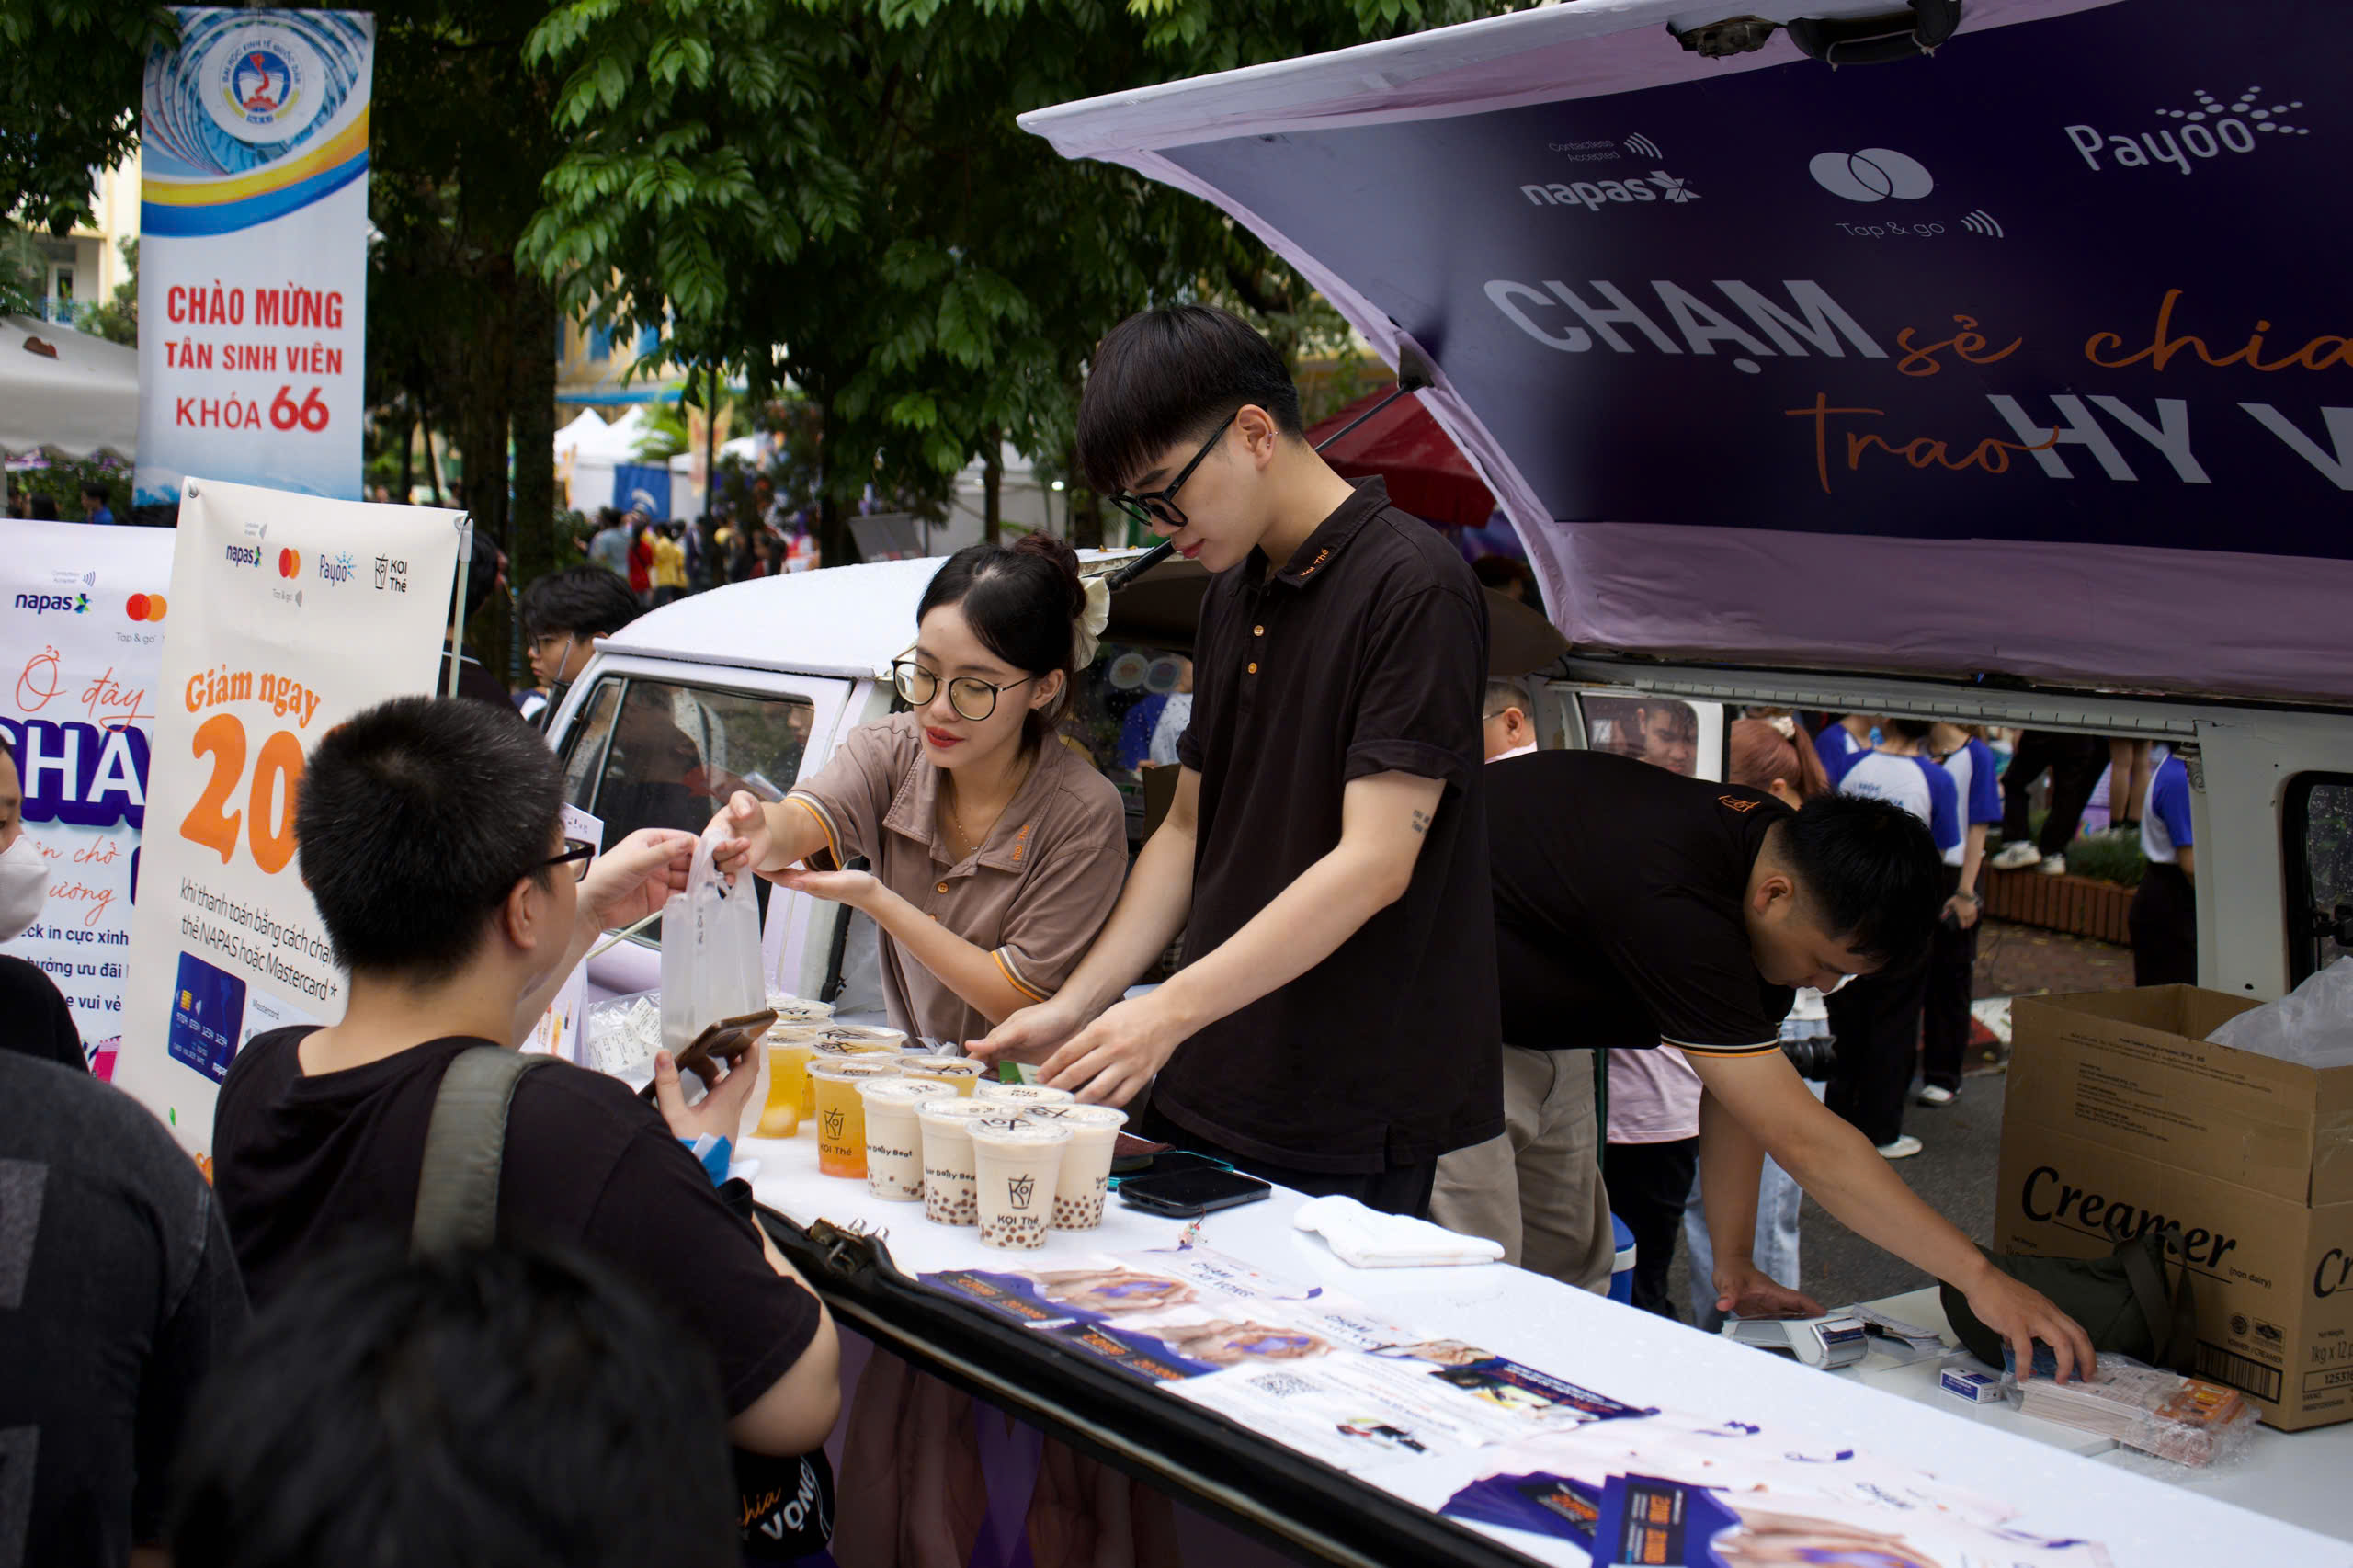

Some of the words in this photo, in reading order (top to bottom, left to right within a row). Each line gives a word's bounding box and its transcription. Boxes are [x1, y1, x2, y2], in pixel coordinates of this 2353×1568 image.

[2064, 118, 2256, 175] Payoo
[1519, 178, 1657, 211] napas
[1835, 222, 1885, 239] Tap
[1886, 221, 1911, 235] &
[1913, 222, 1946, 238] go
[167, 278, 244, 326] CHÀO
[255, 280, 344, 330] MỪNG
[1483, 279, 1890, 374] CHẠM
[1896, 313, 2022, 377] sẻ
[2085, 288, 2353, 372] chia
[165, 335, 213, 369] TÂN
[222, 343, 278, 372] SINH
[286, 340, 343, 375] VIÊN
[176, 390, 262, 430] KHÓA
[269, 384, 330, 433] 66
[1985, 393, 2212, 483] HY
[226, 544, 255, 567] napas
[319, 553, 348, 587] Payoo
[390, 559, 408, 574] KOI
[389, 577, 407, 594] Thé
[15, 593, 73, 615] napas
[116, 631, 132, 643] Tap
[133, 632, 142, 643] &
[142, 634, 155, 645] go
[16, 644, 67, 712] Ở
[81, 666, 155, 733] đây
[185, 663, 253, 713] Giảm
[258, 672, 321, 729] ngay
[179, 712, 306, 875] 20
[73, 835, 122, 865] chở
[180, 877, 198, 903] khi
[198, 885, 229, 917] thanh
[229, 902, 254, 929] toán
[255, 907, 282, 948] bằng
[282, 923, 309, 954] cách
[21, 924, 43, 939] ck
[48, 924, 62, 940] in
[65, 928, 94, 945] cực
[97, 930, 129, 946] xinh
[77, 963, 96, 977] ưu
[99, 962, 122, 979] đãi
[181, 912, 199, 940] thẻ
[199, 921, 240, 958] NAPAS
[239, 936, 266, 972] hoặc
[265, 951, 329, 1002] Mastercard
[78, 994, 100, 1010] vui
[105, 994, 122, 1012] vẻ
[834, 1145, 853, 1157] Thé
[959, 1172, 975, 1182] Bea
[997, 1214, 1017, 1226] KOI
[1021, 1213, 1040, 1225] Thé
[2021, 1165, 2237, 1269] Creamer
[2228, 1265, 2248, 1281] (non
[2248, 1271, 2272, 1290] dairy)
[2311, 1345, 2327, 1365] 1kg
[2337, 1340, 2347, 1359] 12
